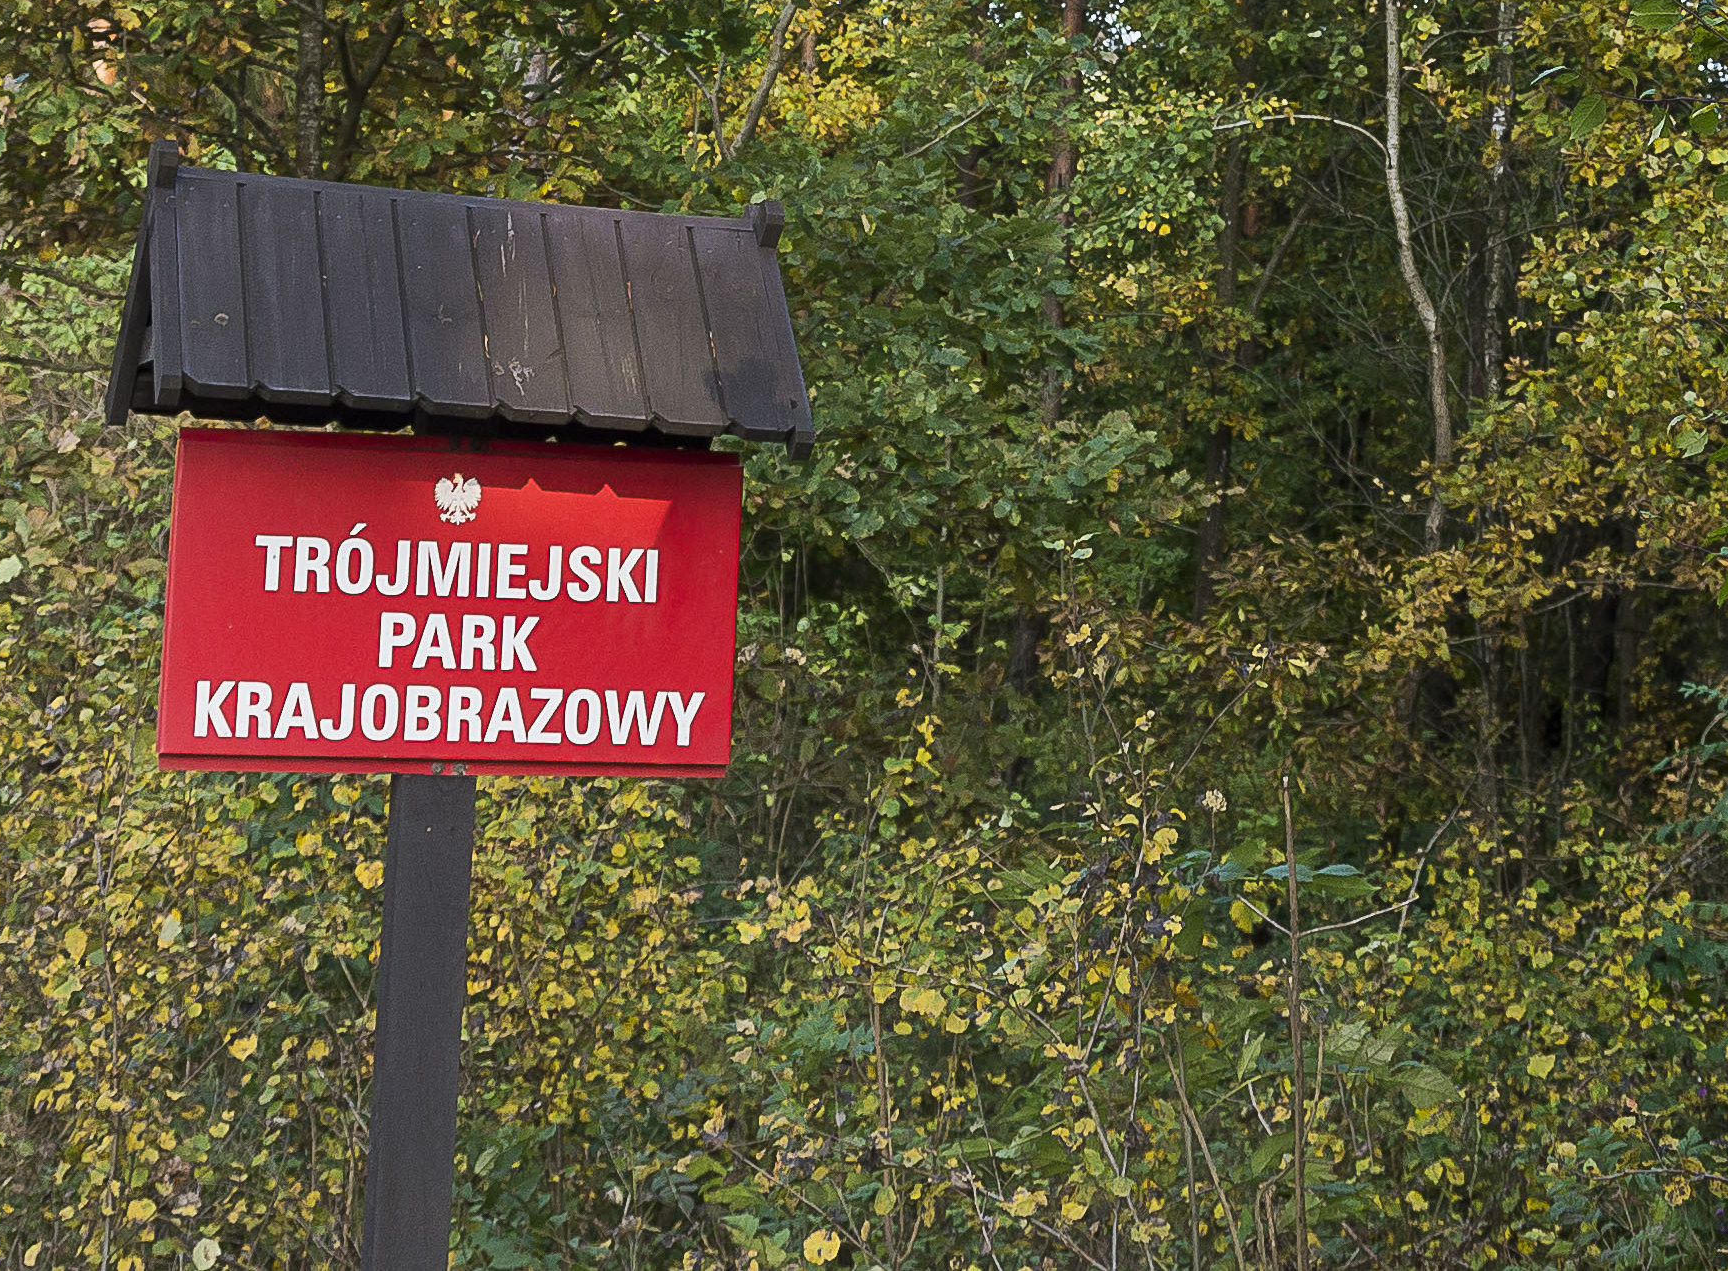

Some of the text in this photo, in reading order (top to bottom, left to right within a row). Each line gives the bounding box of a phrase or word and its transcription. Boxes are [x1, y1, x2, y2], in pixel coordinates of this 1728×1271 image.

[254, 522, 660, 604] TRÓJMIEJSKI
[377, 611, 540, 672] PARK
[193, 679, 706, 747] KRAJOBRAZOWY
